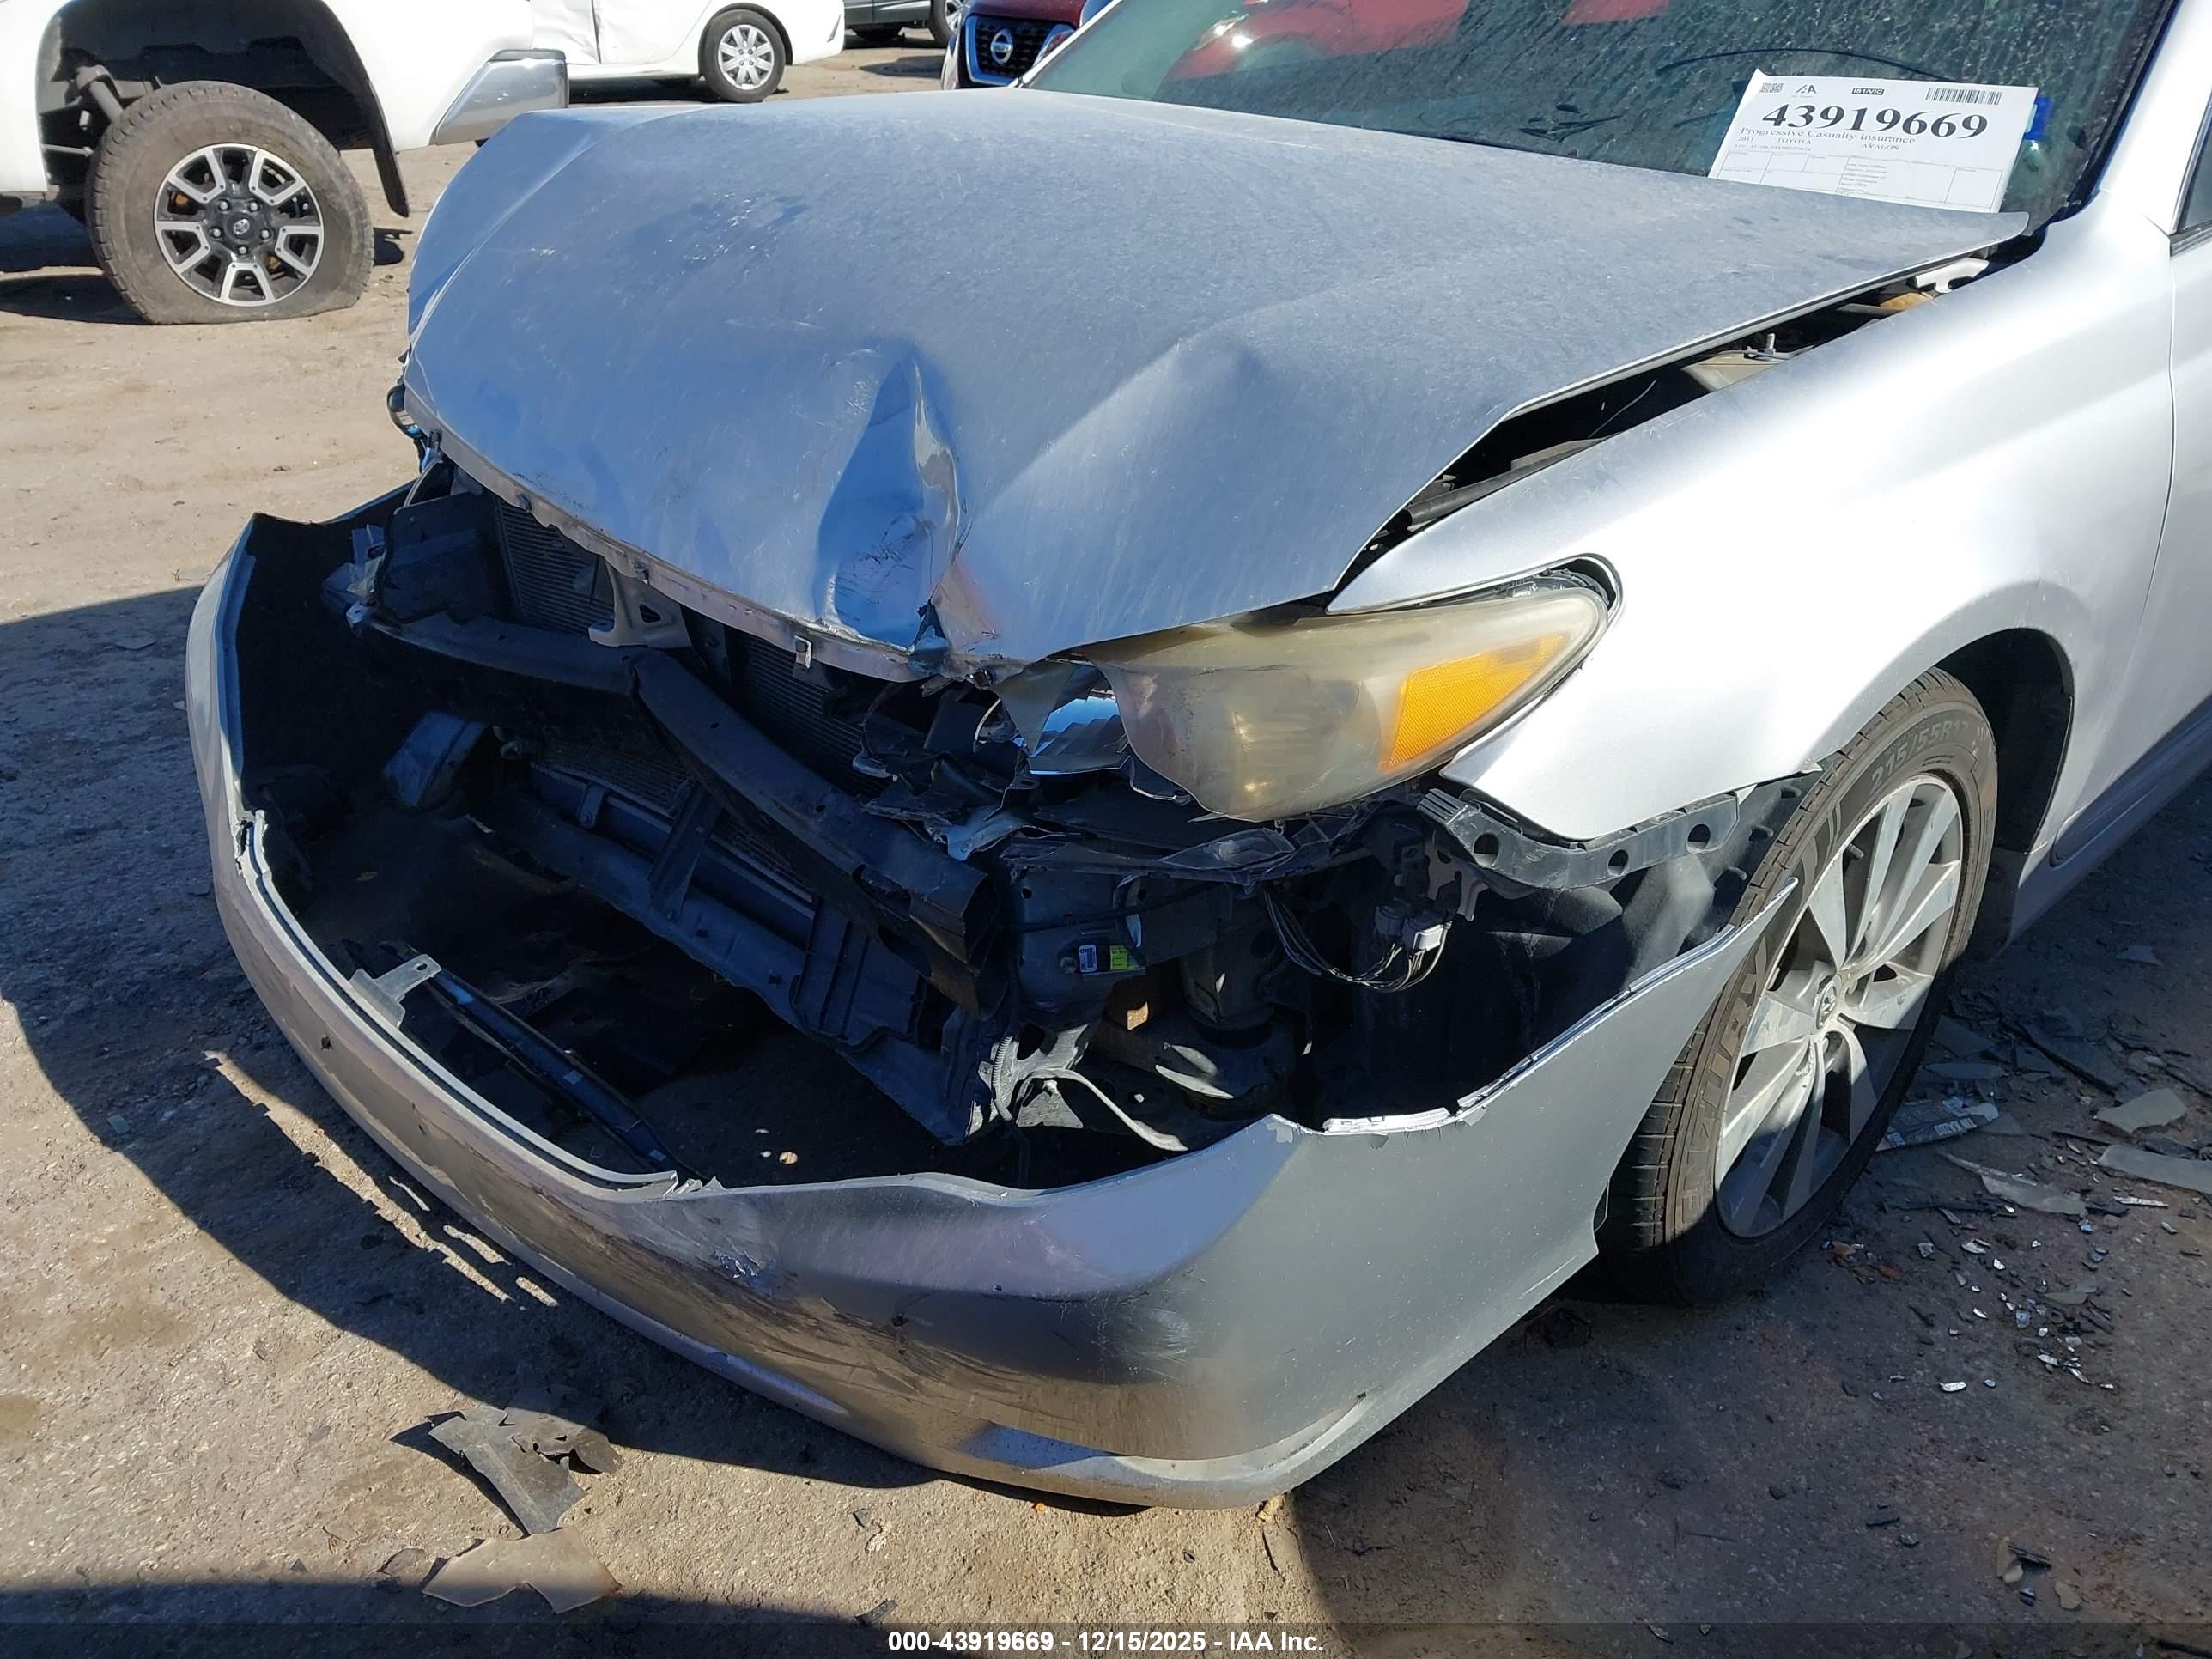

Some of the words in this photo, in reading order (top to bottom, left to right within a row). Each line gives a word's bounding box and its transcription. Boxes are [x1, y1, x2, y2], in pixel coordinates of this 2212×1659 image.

[1761, 103, 1988, 139] 43919669
[1740, 127, 1805, 137] Progressive
[1807, 130, 1856, 140] Casualty
[1860, 133, 1917, 144] Insurance
